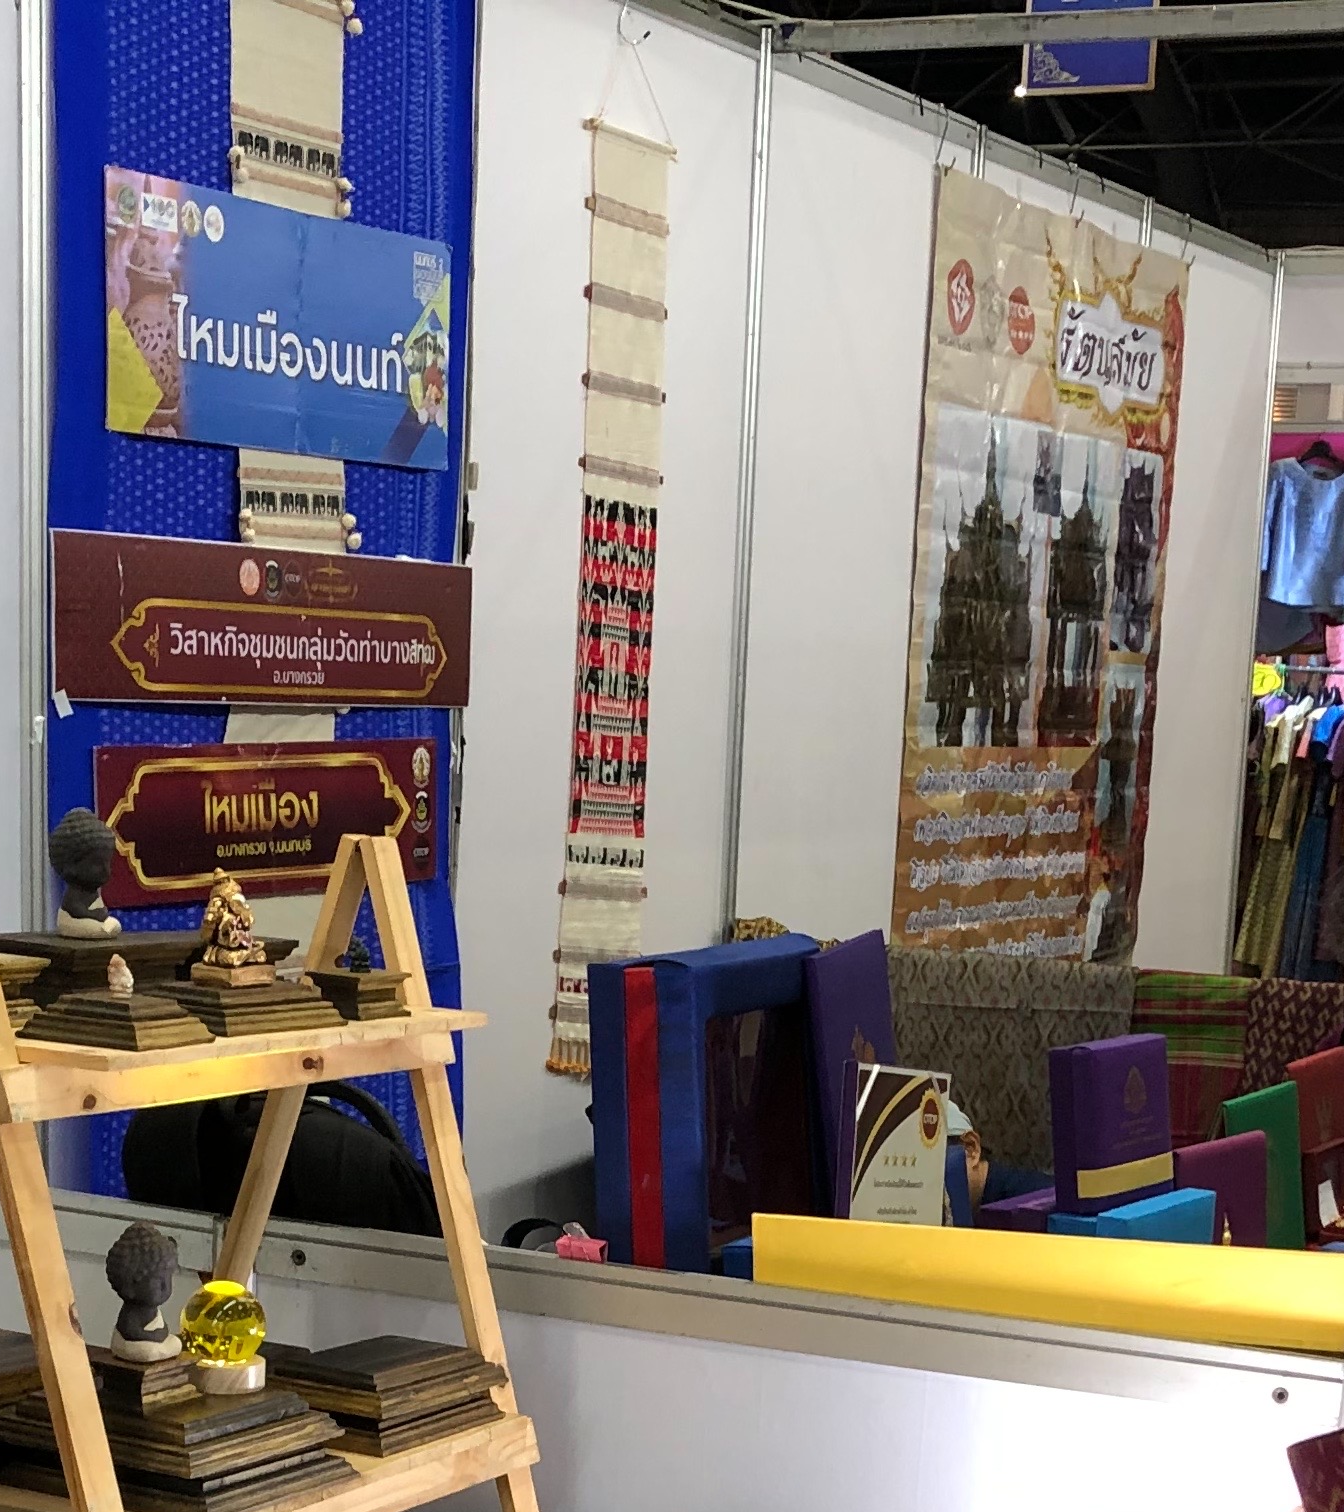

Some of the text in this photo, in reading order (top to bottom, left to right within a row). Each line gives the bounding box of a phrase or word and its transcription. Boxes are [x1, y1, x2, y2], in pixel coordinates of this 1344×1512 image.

[172, 292, 404, 393] ไหมเมืองนนท์
